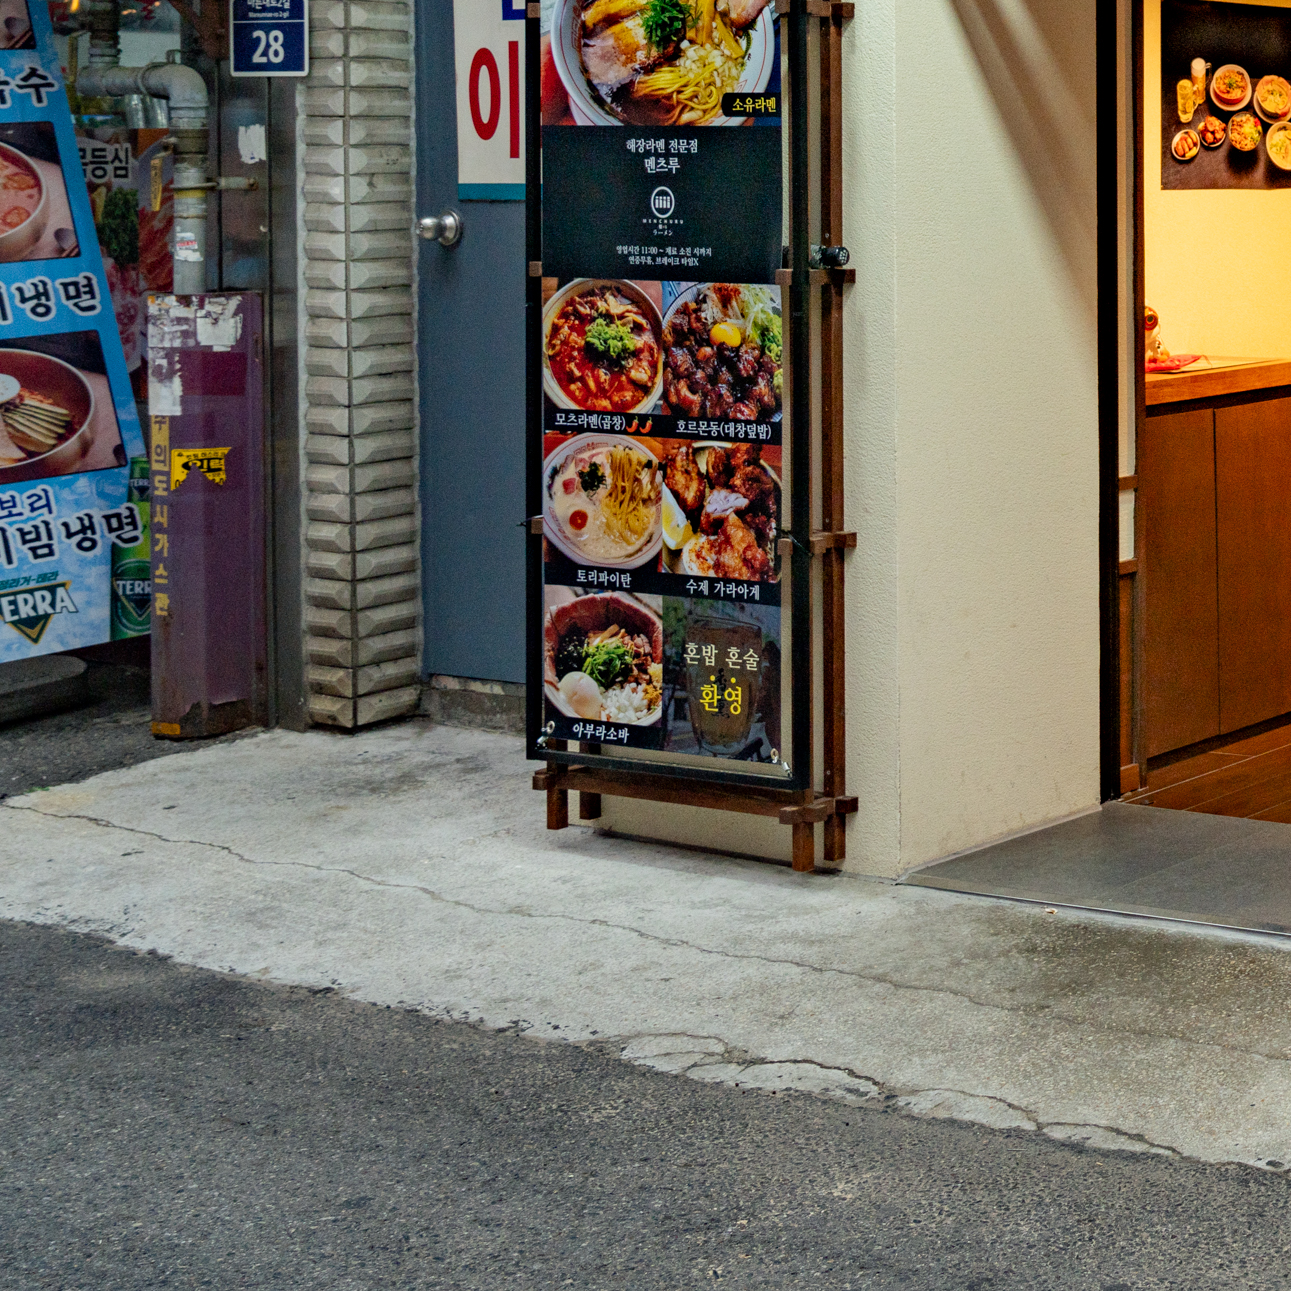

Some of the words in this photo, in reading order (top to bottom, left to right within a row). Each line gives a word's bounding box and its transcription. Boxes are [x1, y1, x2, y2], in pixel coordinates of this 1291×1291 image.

[252, 29, 285, 63] 28
[732, 96, 777, 114] 소유라멘
[626, 138, 665, 154] 해장라멘
[668, 138, 698, 154] 전문점
[644, 156, 681, 174] 멘츠루
[616, 245, 640, 255] 영업시간
[641, 246, 658, 254] 11:00
[679, 247, 692, 256] 소진
[0, 275, 97, 321] 냉면
[554, 412, 626, 432] 모츠라멘(곱창)
[676, 418, 772, 441] 호르몬동(대창덮밥)
[0, 507, 139, 565] 빔냉면
[154, 475, 170, 616] 도시가스관
[576, 569, 632, 589] 토리파이탄
[686, 578, 709, 596] 수제
[713, 580, 760, 602] 가라아게
[683, 642, 719, 667] 혼밥
[726, 646, 760, 672] 혼술
[699, 684, 743, 715] 환영
[573, 723, 630, 743] 아부라소바
